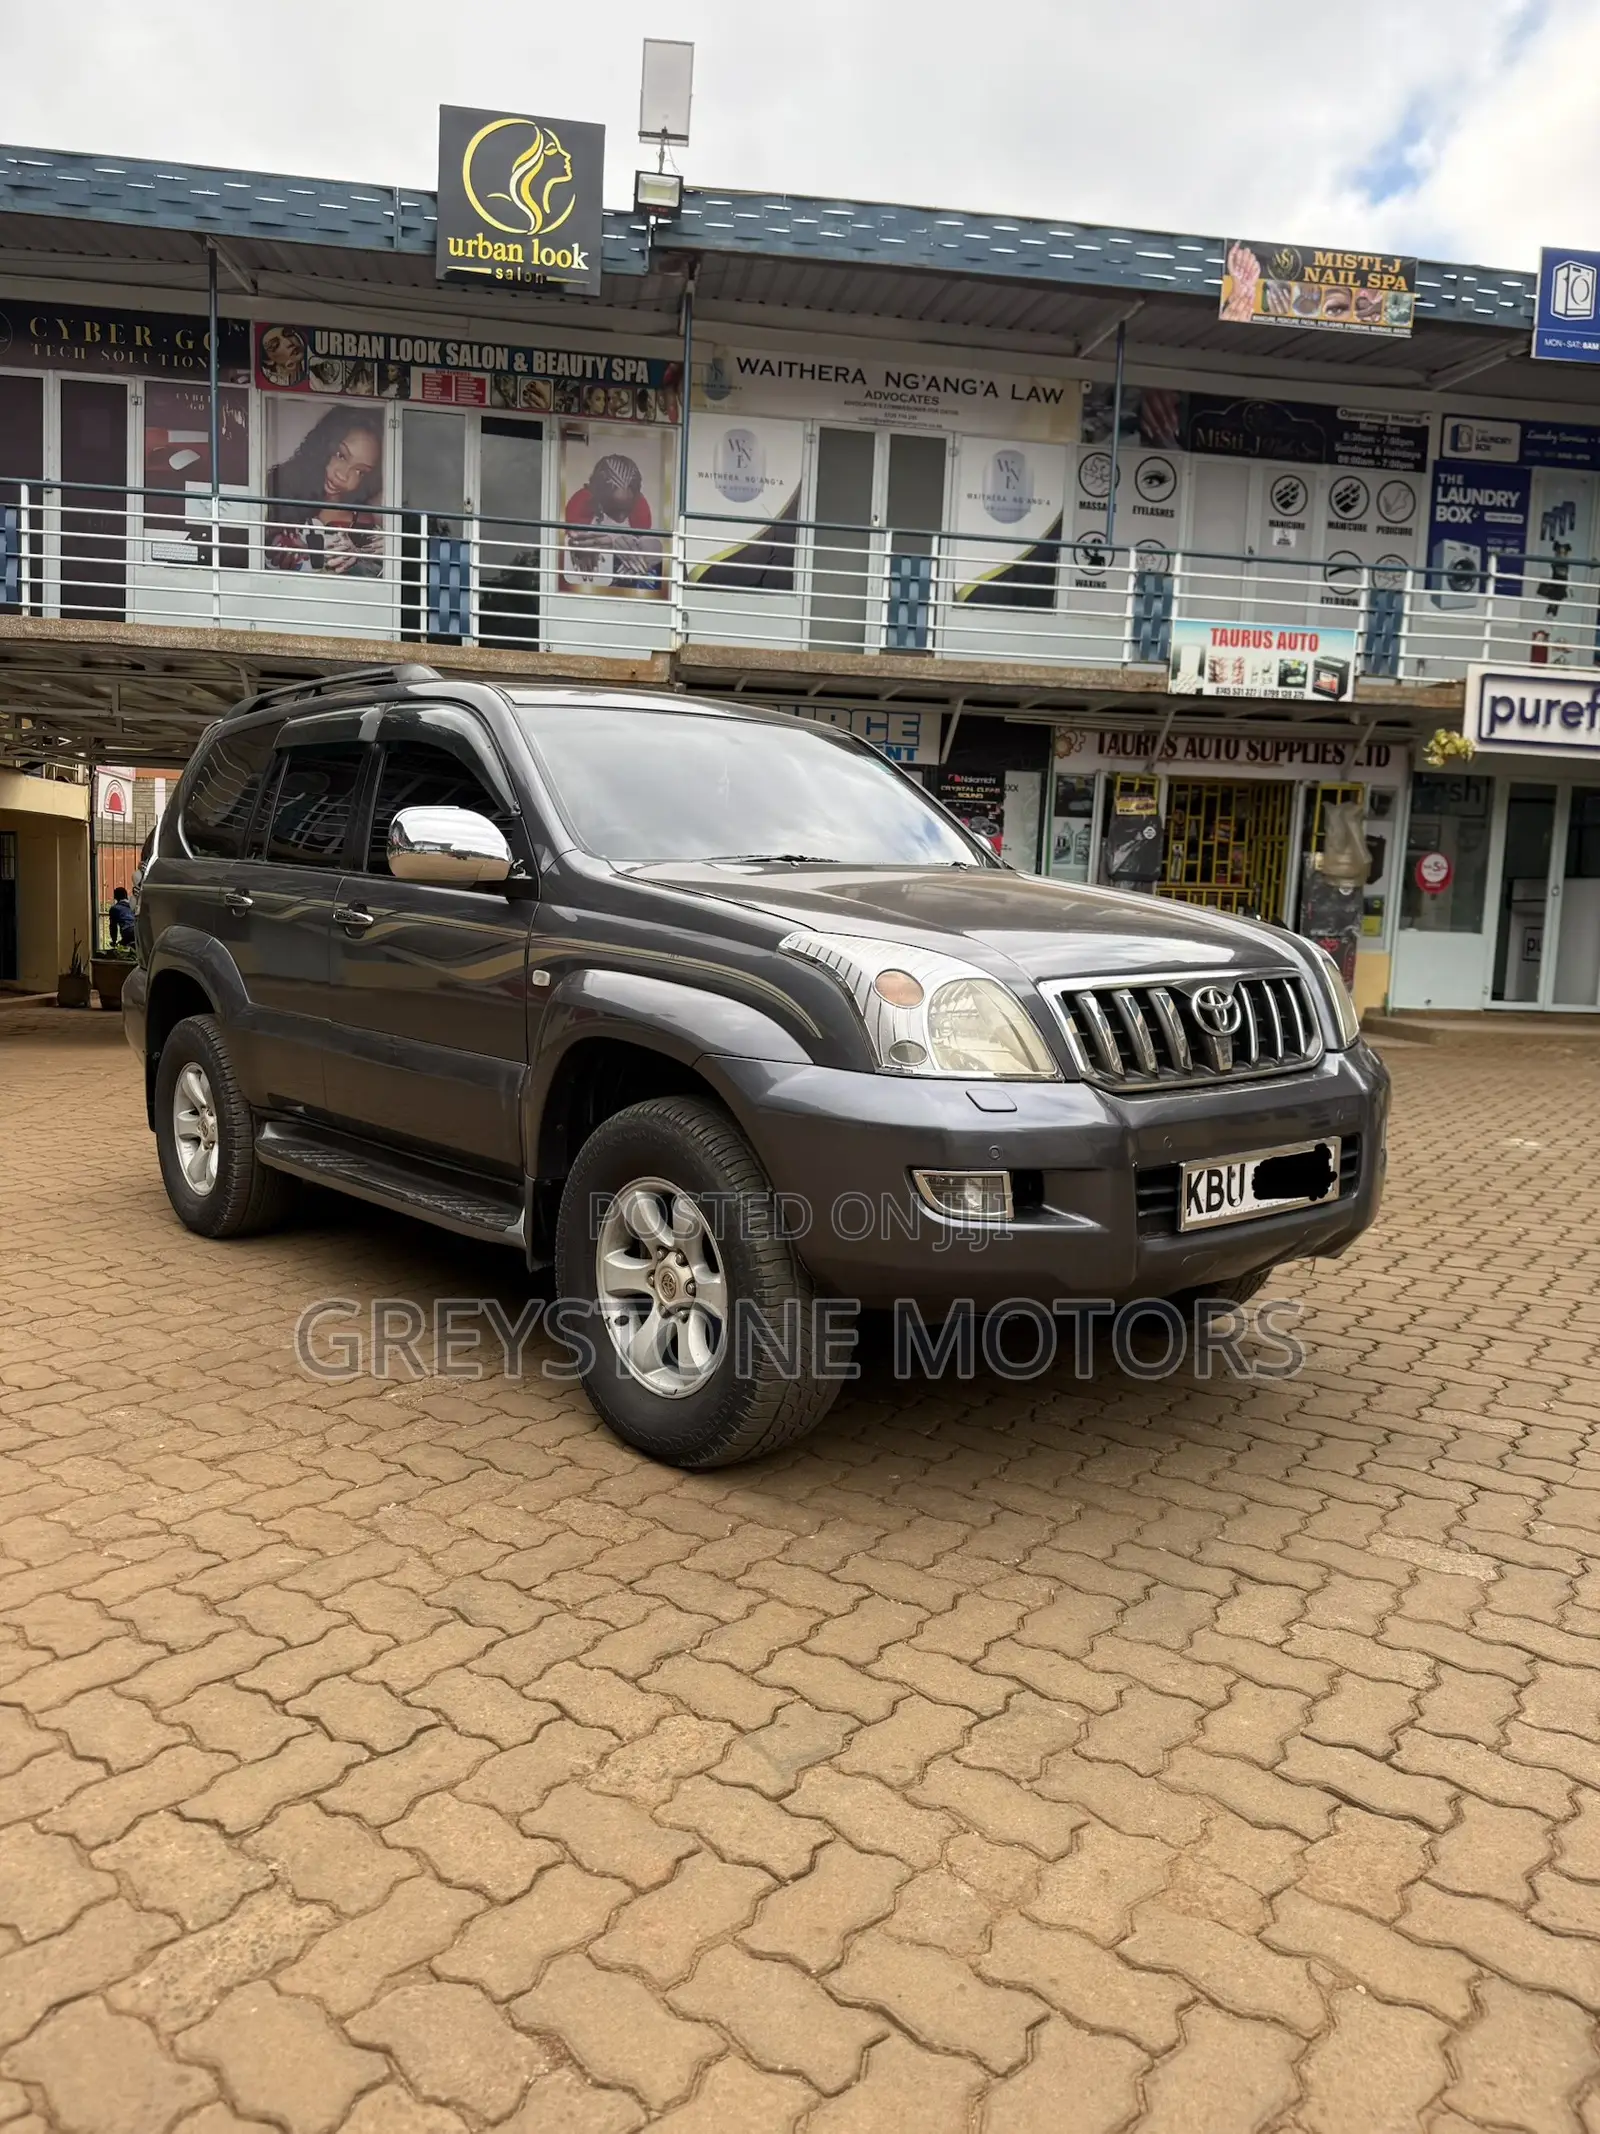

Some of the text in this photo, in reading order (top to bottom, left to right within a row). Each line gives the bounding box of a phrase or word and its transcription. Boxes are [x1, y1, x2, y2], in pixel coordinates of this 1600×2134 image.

[447, 232, 589, 270] urban look
[1314, 250, 1402, 274] MISTI-J
[495, 267, 544, 284] salon
[1303, 267, 1408, 291] NAIL SPA
[31, 343, 220, 369] TECH SOLUTION
[314, 331, 650, 384] URBAN LOOK SALON & BEAUTY SPA
[736, 356, 867, 386] WAITHERA
[1011, 383, 1065, 405] LAW
[864, 389, 940, 406] ADVOCATES
[1439, 473, 1464, 485] THE
[1079, 500, 1117, 513] MASSA
[1436, 485, 1521, 509] LAUNDRY
[1132, 505, 1175, 519] EYELASHES
[1435, 505, 1473, 524] BOX
[1327, 520, 1368, 533] MANICURE
[1075, 578, 1107, 589] WAXING
[1210, 627, 1320, 652] TAURUS AUTO
[1184, 736, 1240, 760] AUTO
[1246, 739, 1345, 765] SUPPLIES
[960, 775, 997, 785] Nakamichi
[1187, 1163, 1246, 1217] KBU
